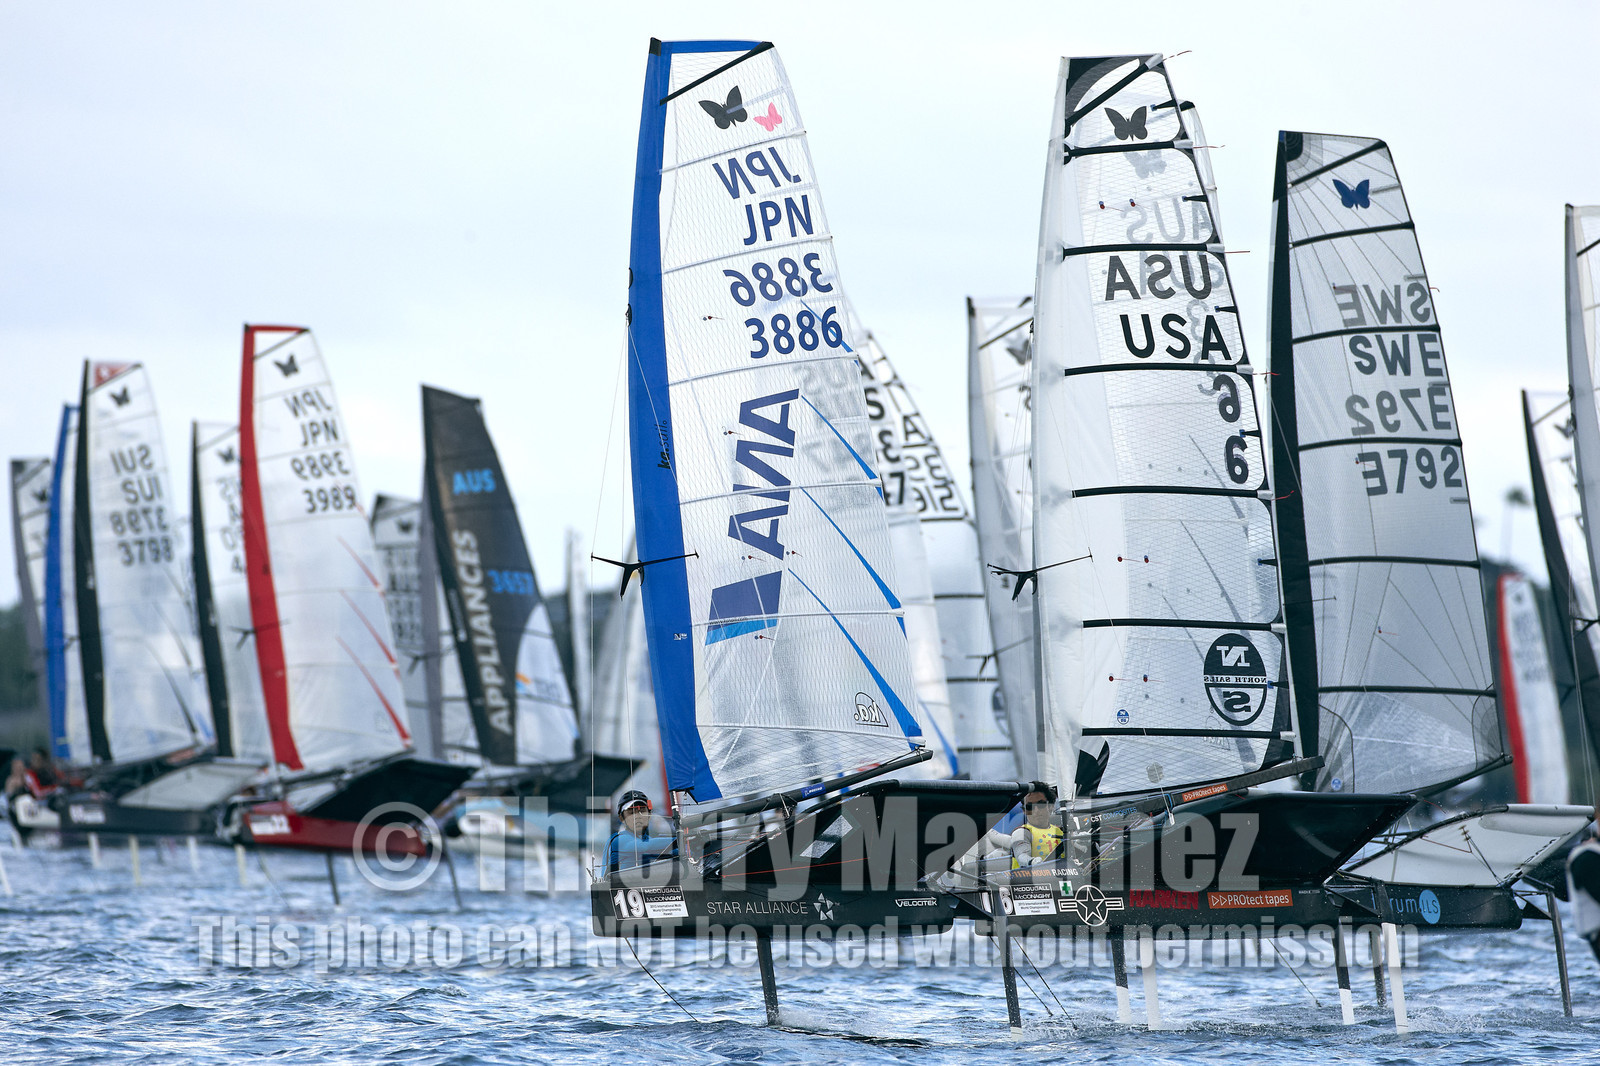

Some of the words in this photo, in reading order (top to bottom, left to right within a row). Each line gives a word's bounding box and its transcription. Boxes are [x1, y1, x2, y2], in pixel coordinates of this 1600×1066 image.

[743, 194, 814, 246] JPN
[744, 305, 843, 359] 3886
[1119, 313, 1232, 360] USA
[1348, 332, 1444, 377] SWE
[300, 419, 339, 447] JPN
[1223, 434, 1249, 485] 6
[121, 474, 163, 504] SUI
[452, 468, 497, 496] AUS
[302, 485, 356, 514] 3989
[451, 528, 514, 736] APPLIANCES
[1090, 814, 1102, 823] CST
[1103, 806, 1137, 820] COMPOSITES
[1052, 868, 1079, 876] RACING
[613, 889, 645, 918] 19
[706, 901, 742, 915] STAR
[745, 901, 809, 915] ALLIANCE
[895, 898, 938, 908] VELOCITEK
[1128, 888, 1200, 911] HARKEN
[1227, 894, 1264, 906] PROtect
[1264, 893, 1291, 907] tapes
